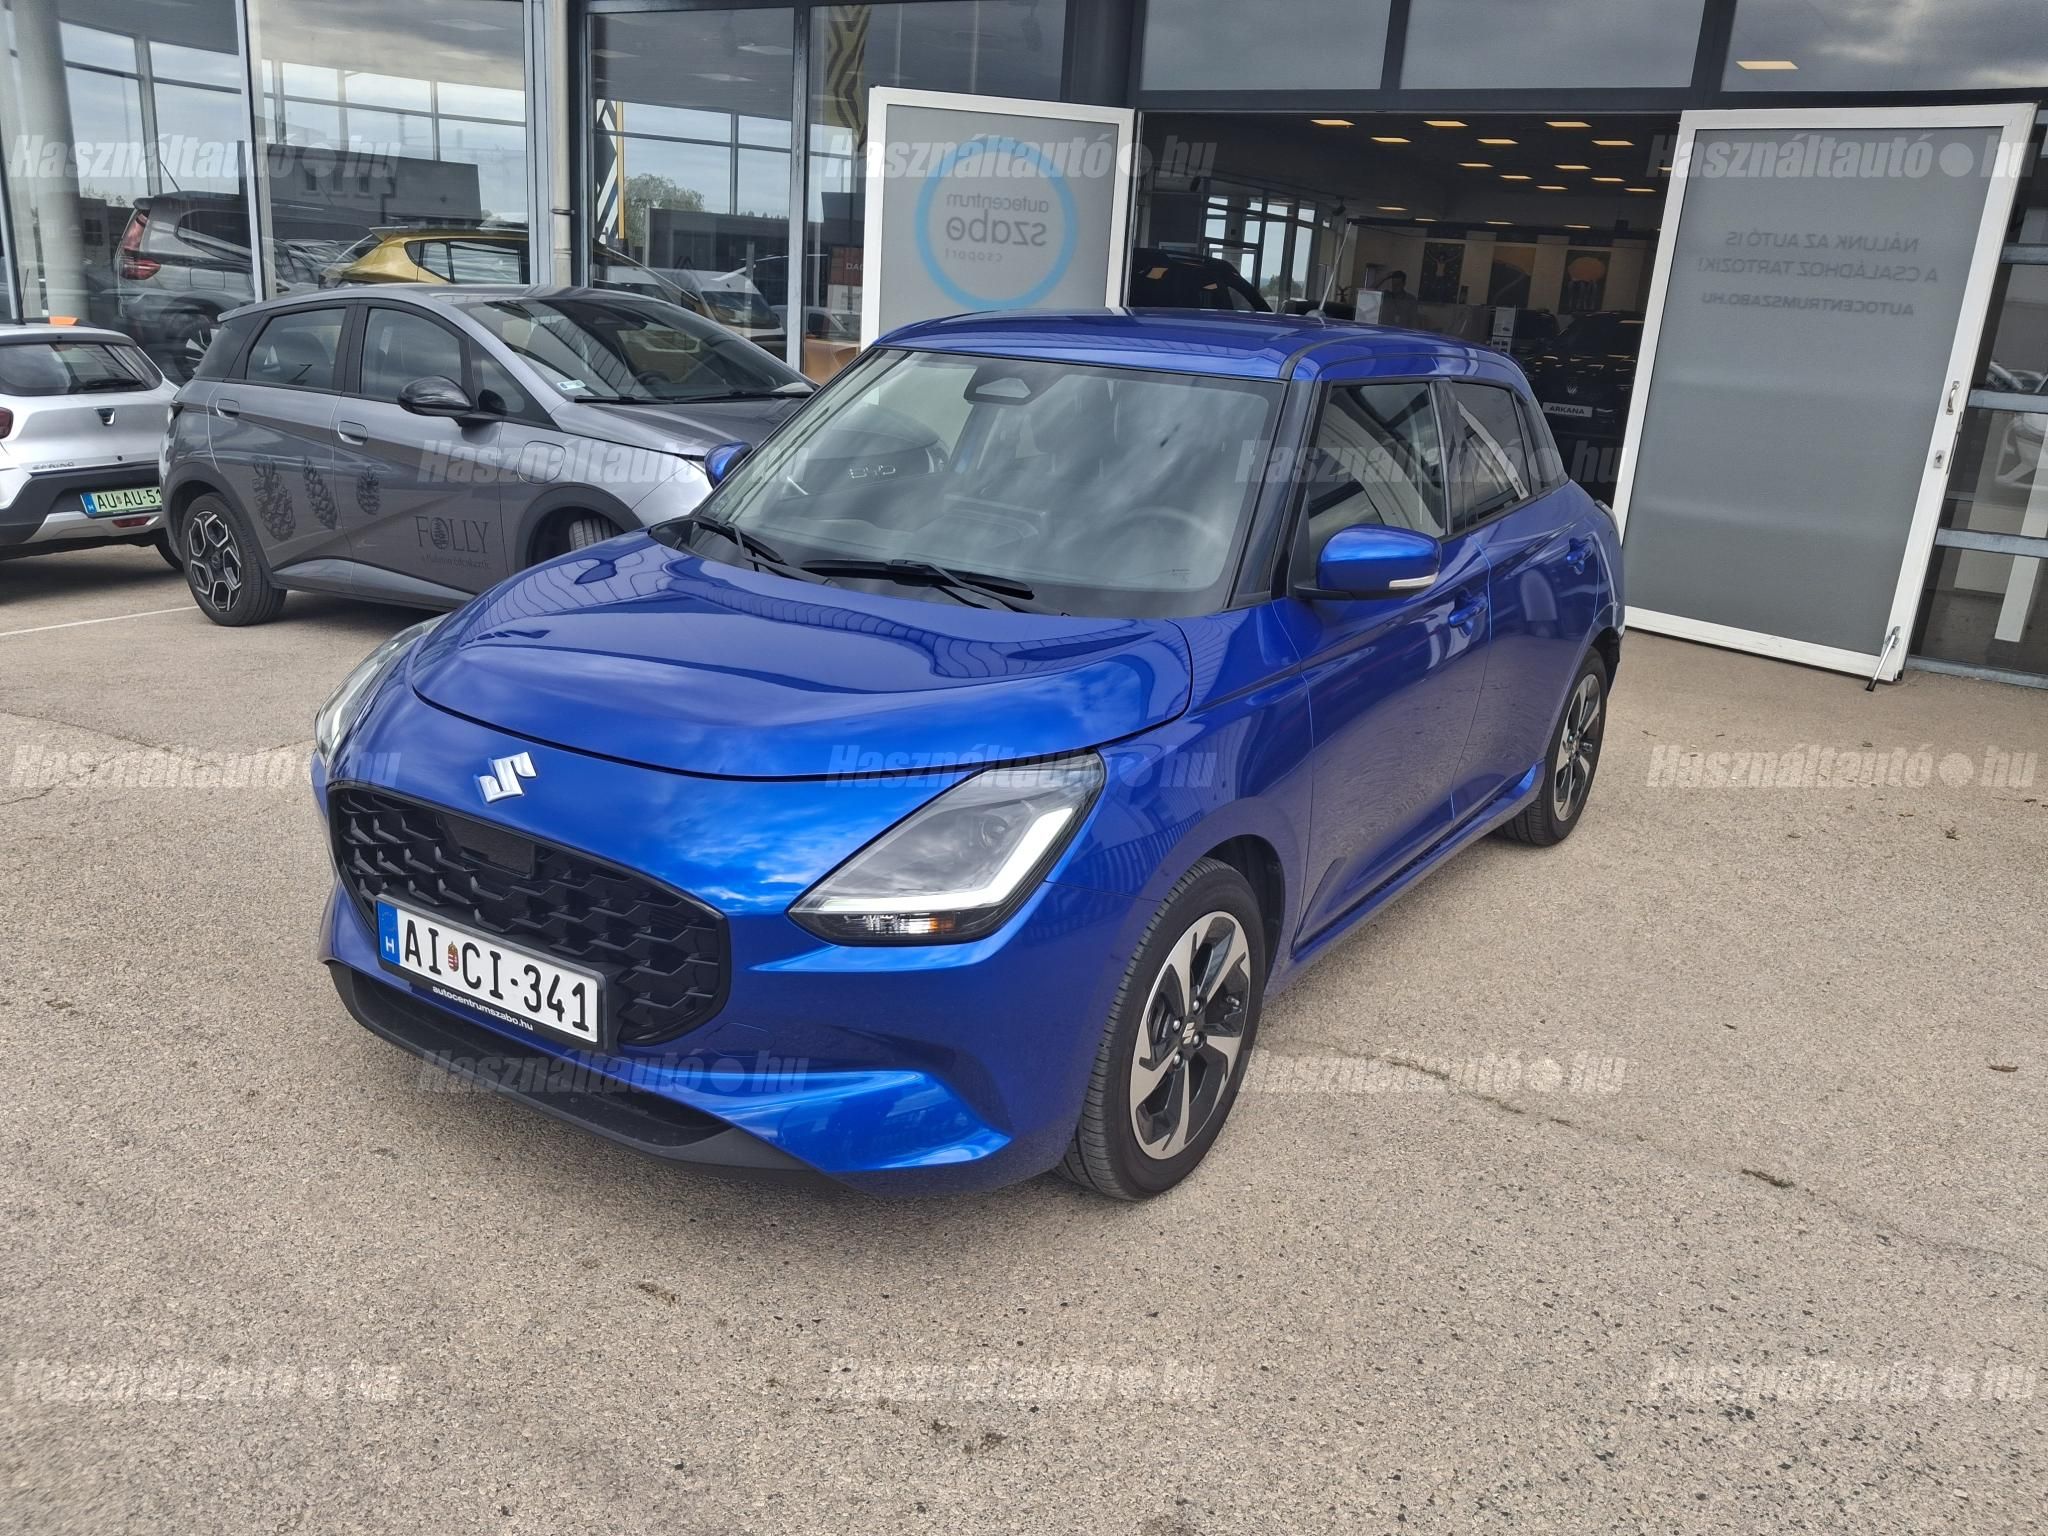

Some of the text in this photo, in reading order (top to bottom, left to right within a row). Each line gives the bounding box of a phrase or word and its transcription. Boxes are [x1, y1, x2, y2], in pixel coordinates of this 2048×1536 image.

[1549, 405, 1585, 415] ARKANA
[97, 494, 118, 510] AU
[414, 515, 490, 553] FOLLY
[385, 936, 395, 954] H
[404, 918, 443, 976] AI
[432, 984, 534, 1032] autocentrumszabo.hu
